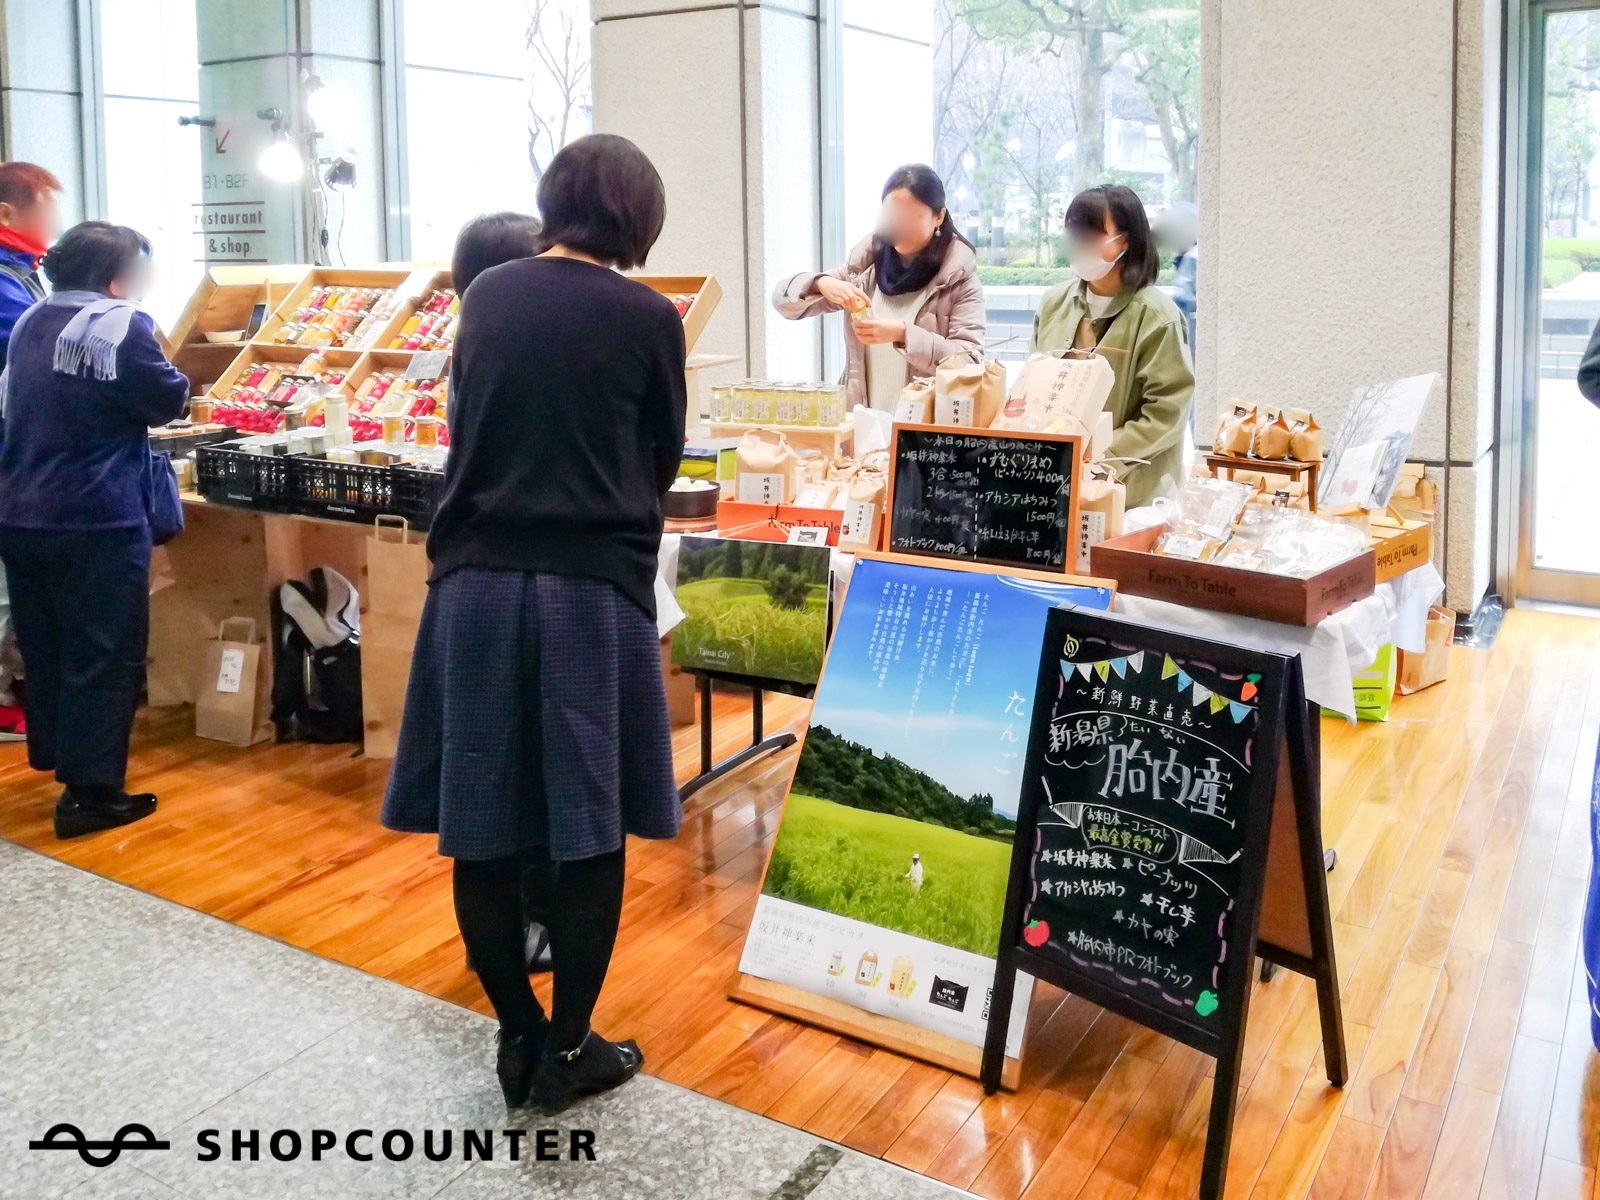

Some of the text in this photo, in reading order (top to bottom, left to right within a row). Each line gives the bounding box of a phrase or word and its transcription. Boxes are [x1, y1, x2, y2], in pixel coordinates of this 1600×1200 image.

[194, 210, 262, 225] restaurant
[208, 236, 250, 258] & shop
[1148, 568, 1237, 597] Farm To Table
[1049, 716, 1114, 753] 新潟県
[1098, 738, 1236, 829] 胎内産
